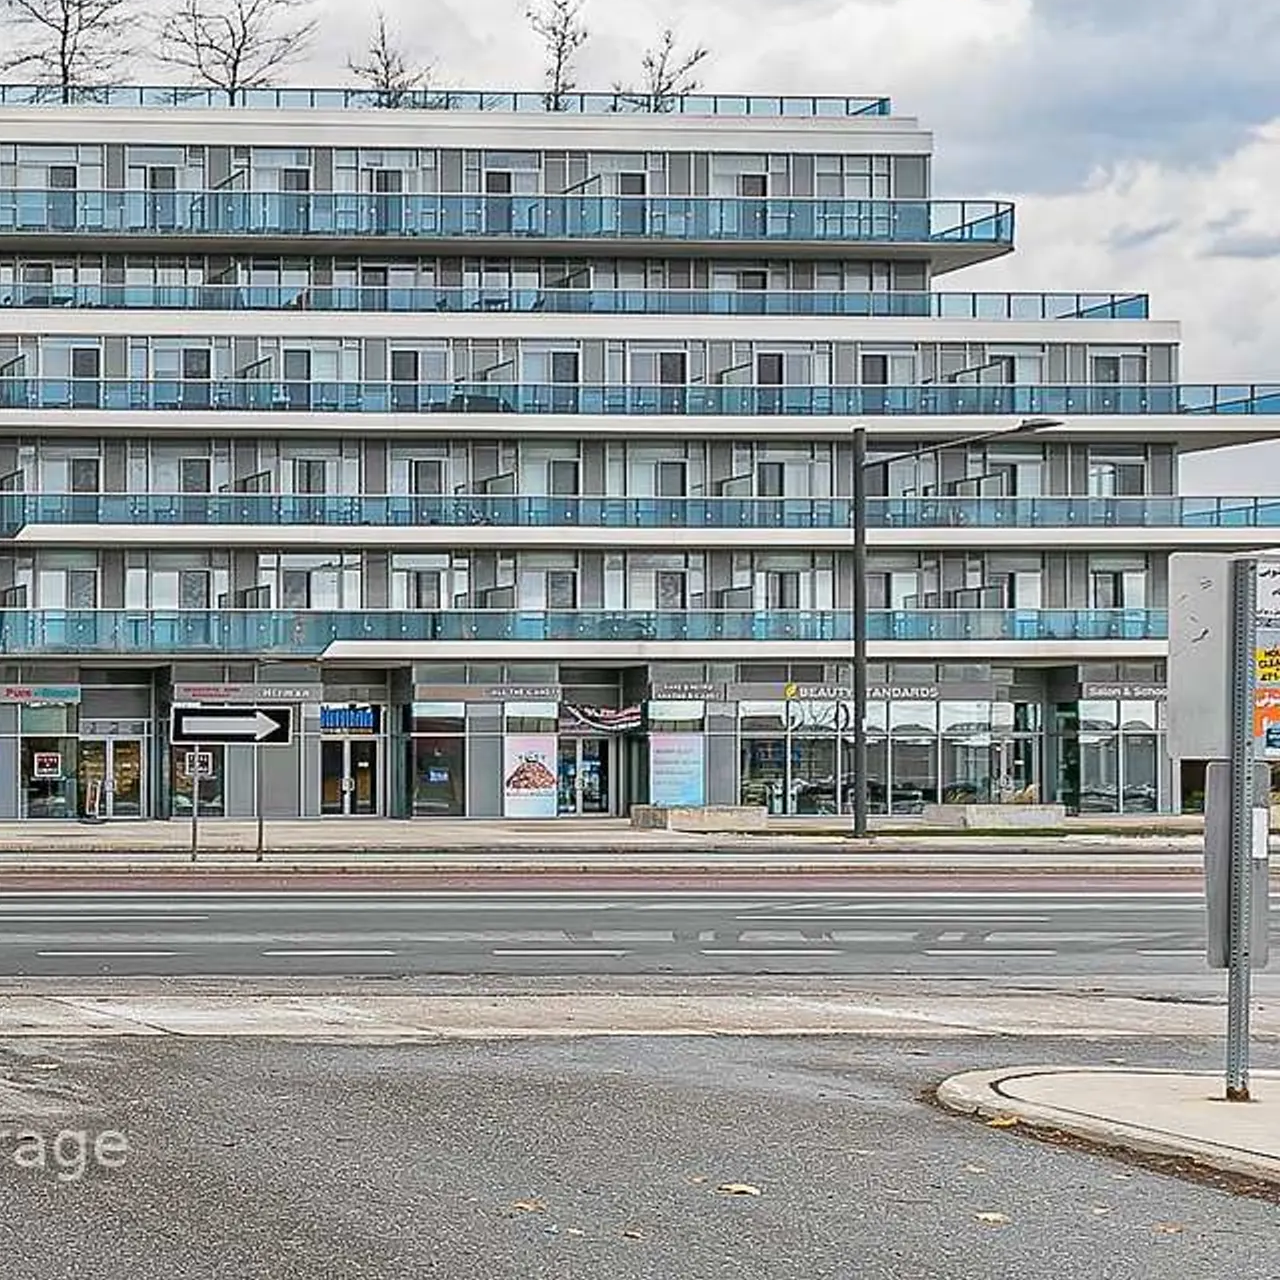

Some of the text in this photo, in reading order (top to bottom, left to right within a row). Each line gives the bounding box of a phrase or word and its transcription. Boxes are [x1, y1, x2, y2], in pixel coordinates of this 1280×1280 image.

[798, 686, 940, 699] BEAUTY TANDARDS
[1087, 686, 1121, 697] Salon
[1133, 686, 1169, 697] Schoo
